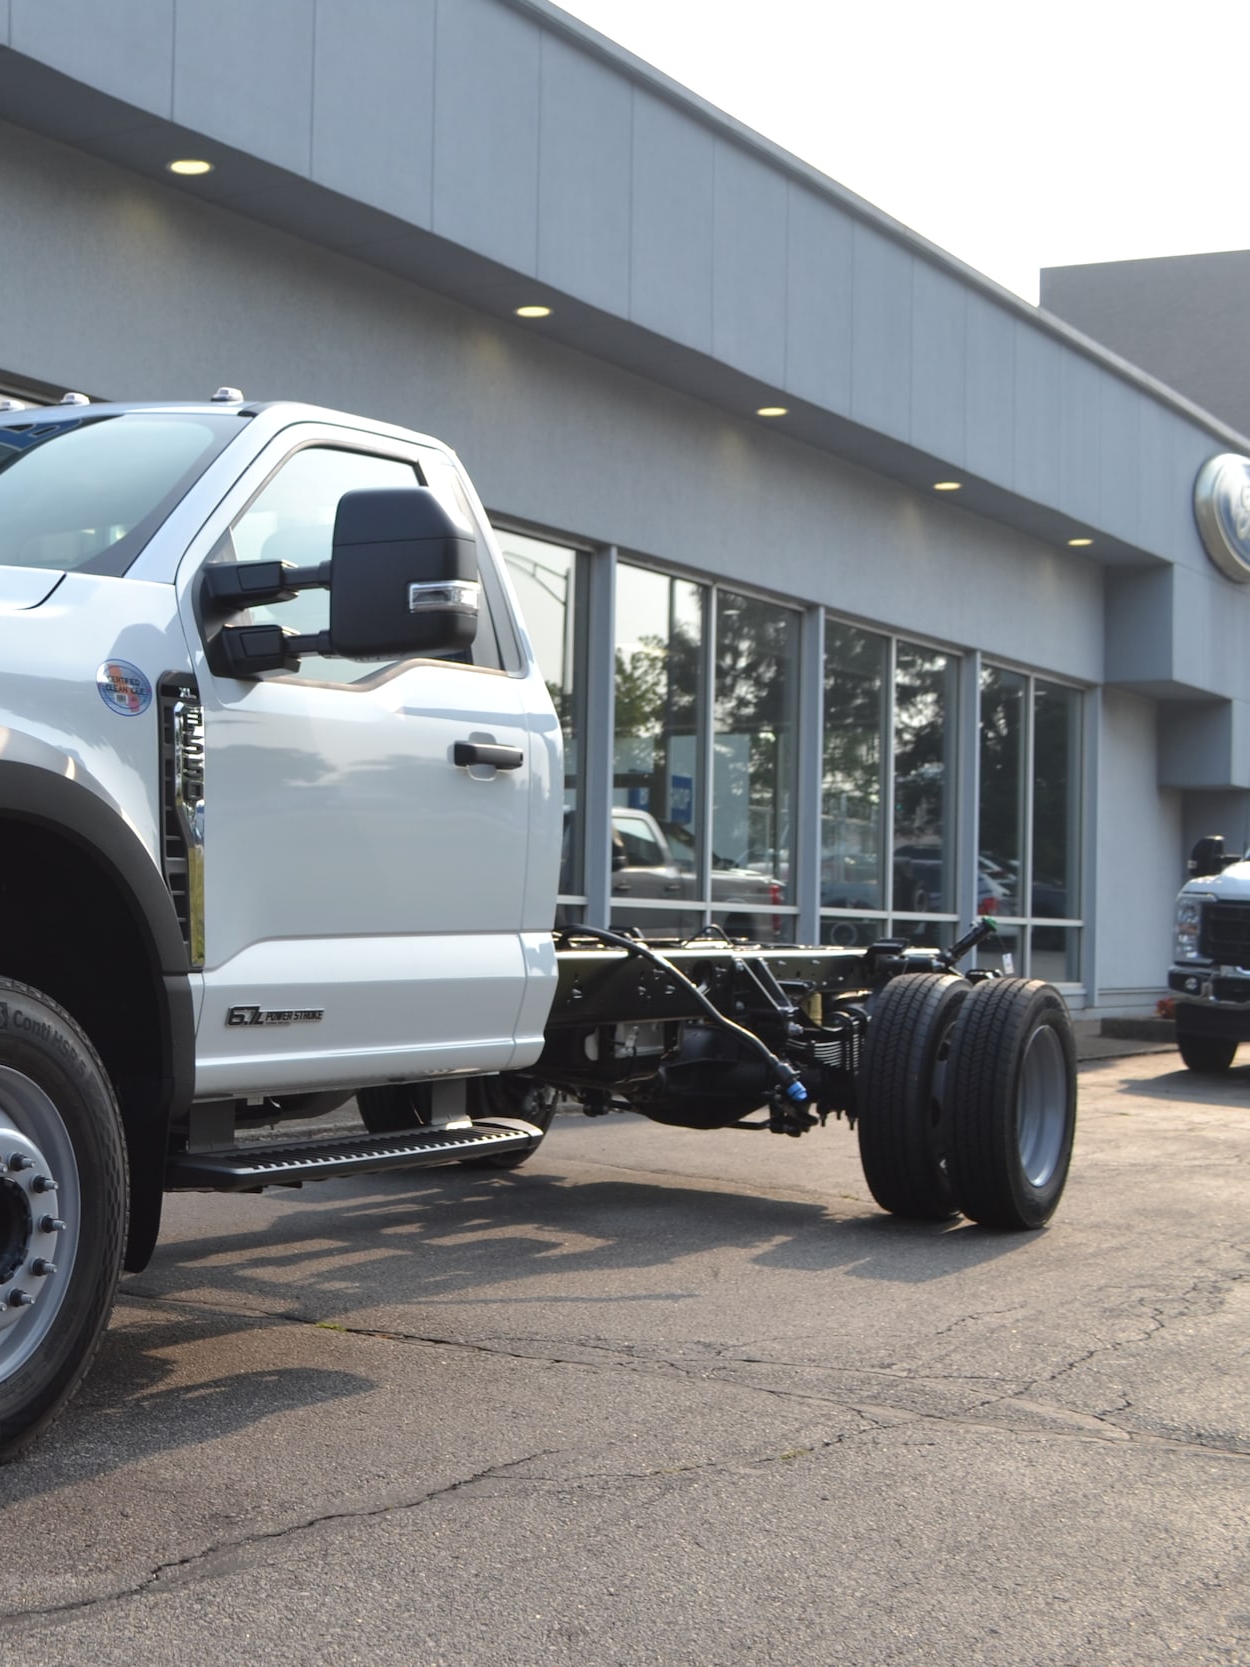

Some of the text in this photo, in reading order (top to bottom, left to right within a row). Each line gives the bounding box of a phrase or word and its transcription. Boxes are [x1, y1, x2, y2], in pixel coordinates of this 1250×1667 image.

[178, 687, 197, 700] XL
[265, 1010, 292, 1022] POWER
[292, 1009, 324, 1021] STROKE
[13, 1009, 51, 1042] Conti
